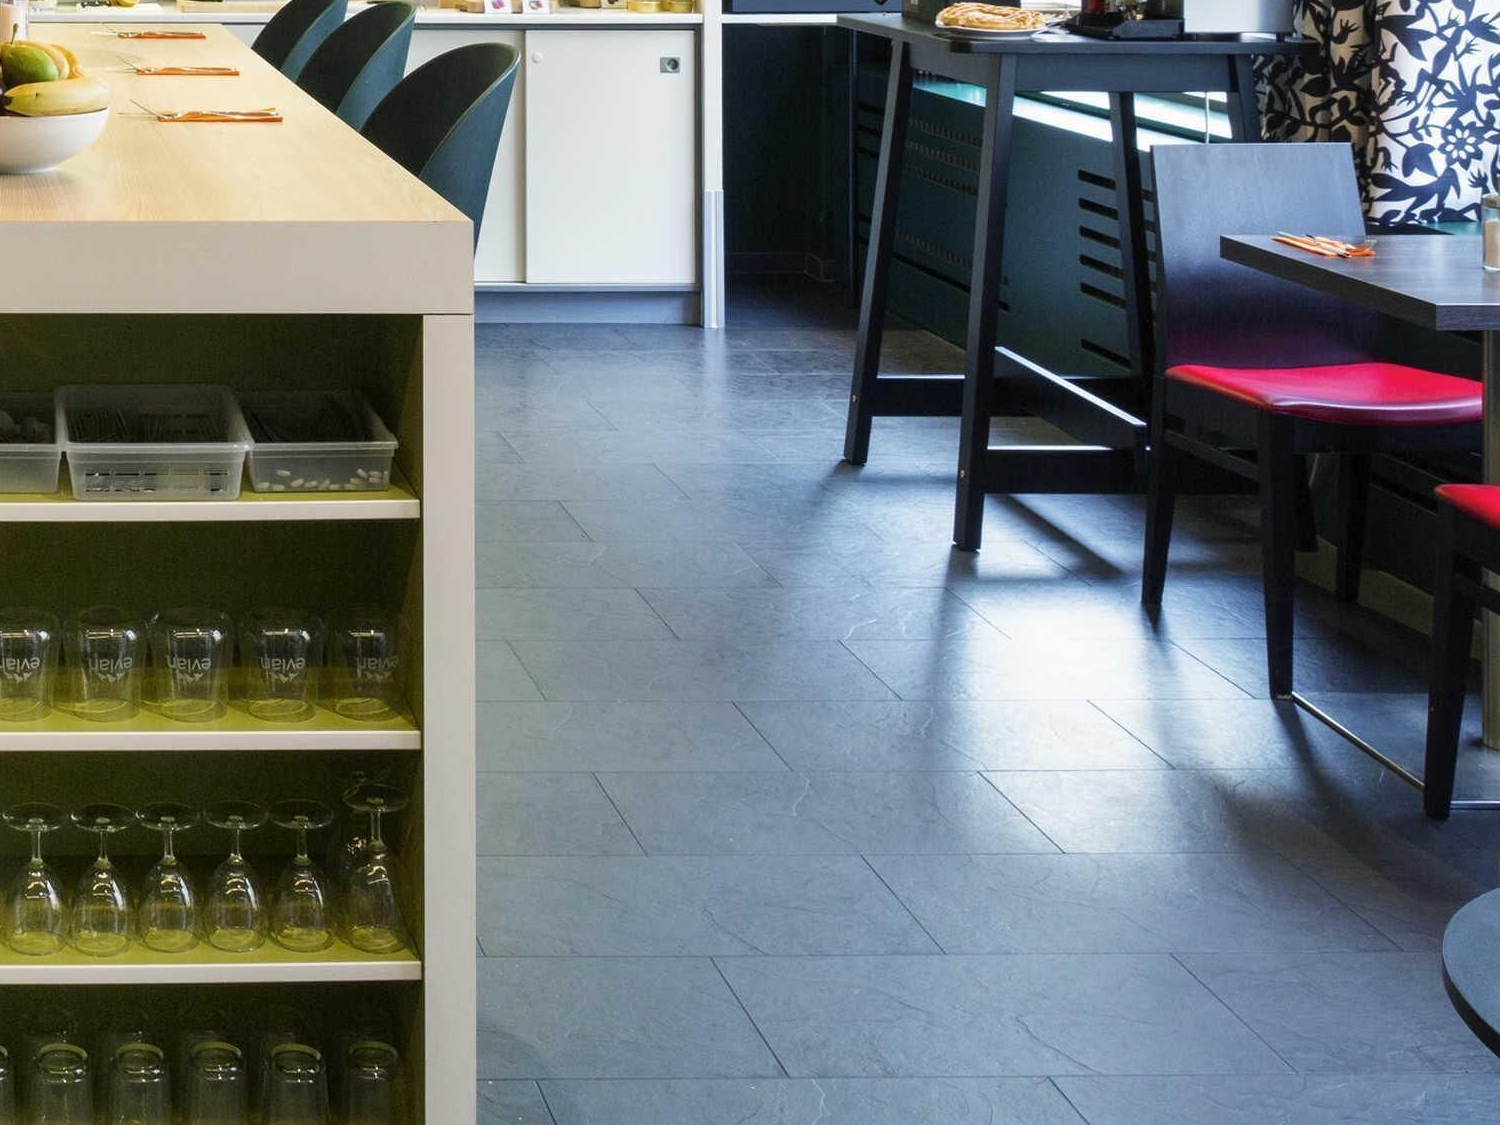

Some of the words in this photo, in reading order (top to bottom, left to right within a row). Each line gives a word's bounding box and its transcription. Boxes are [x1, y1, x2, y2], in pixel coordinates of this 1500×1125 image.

[88, 656, 133, 672] evian
[167, 655, 212, 672] evian
[260, 655, 306, 672] evian
